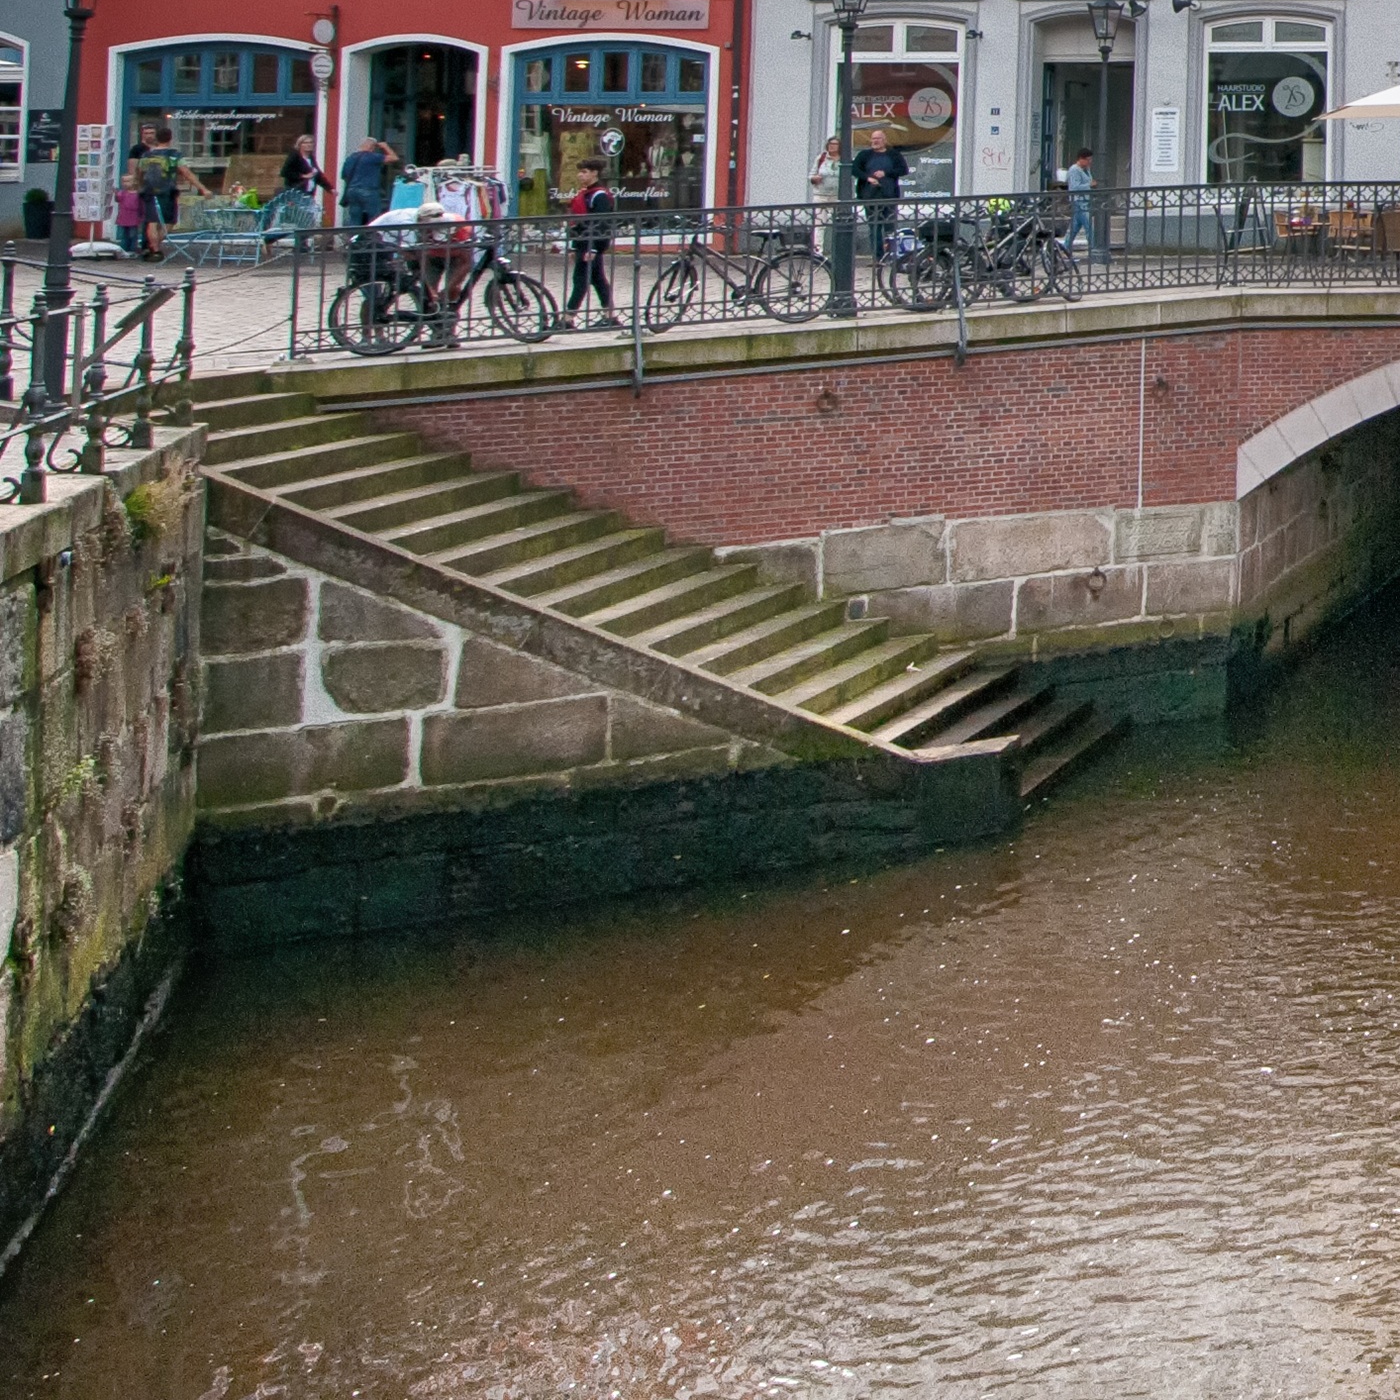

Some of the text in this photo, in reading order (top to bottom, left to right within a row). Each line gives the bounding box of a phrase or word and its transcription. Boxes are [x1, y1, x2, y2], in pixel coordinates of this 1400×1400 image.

[515, 0, 704, 27] Vintage Woman
[1217, 84, 1266, 92] HAARSTUDIO
[851, 103, 895, 118] ALEX
[1217, 94, 1265, 112] ALEX
[551, 107, 675, 127] Vintage Woman
[609, 187, 670, 201] Homeflair
